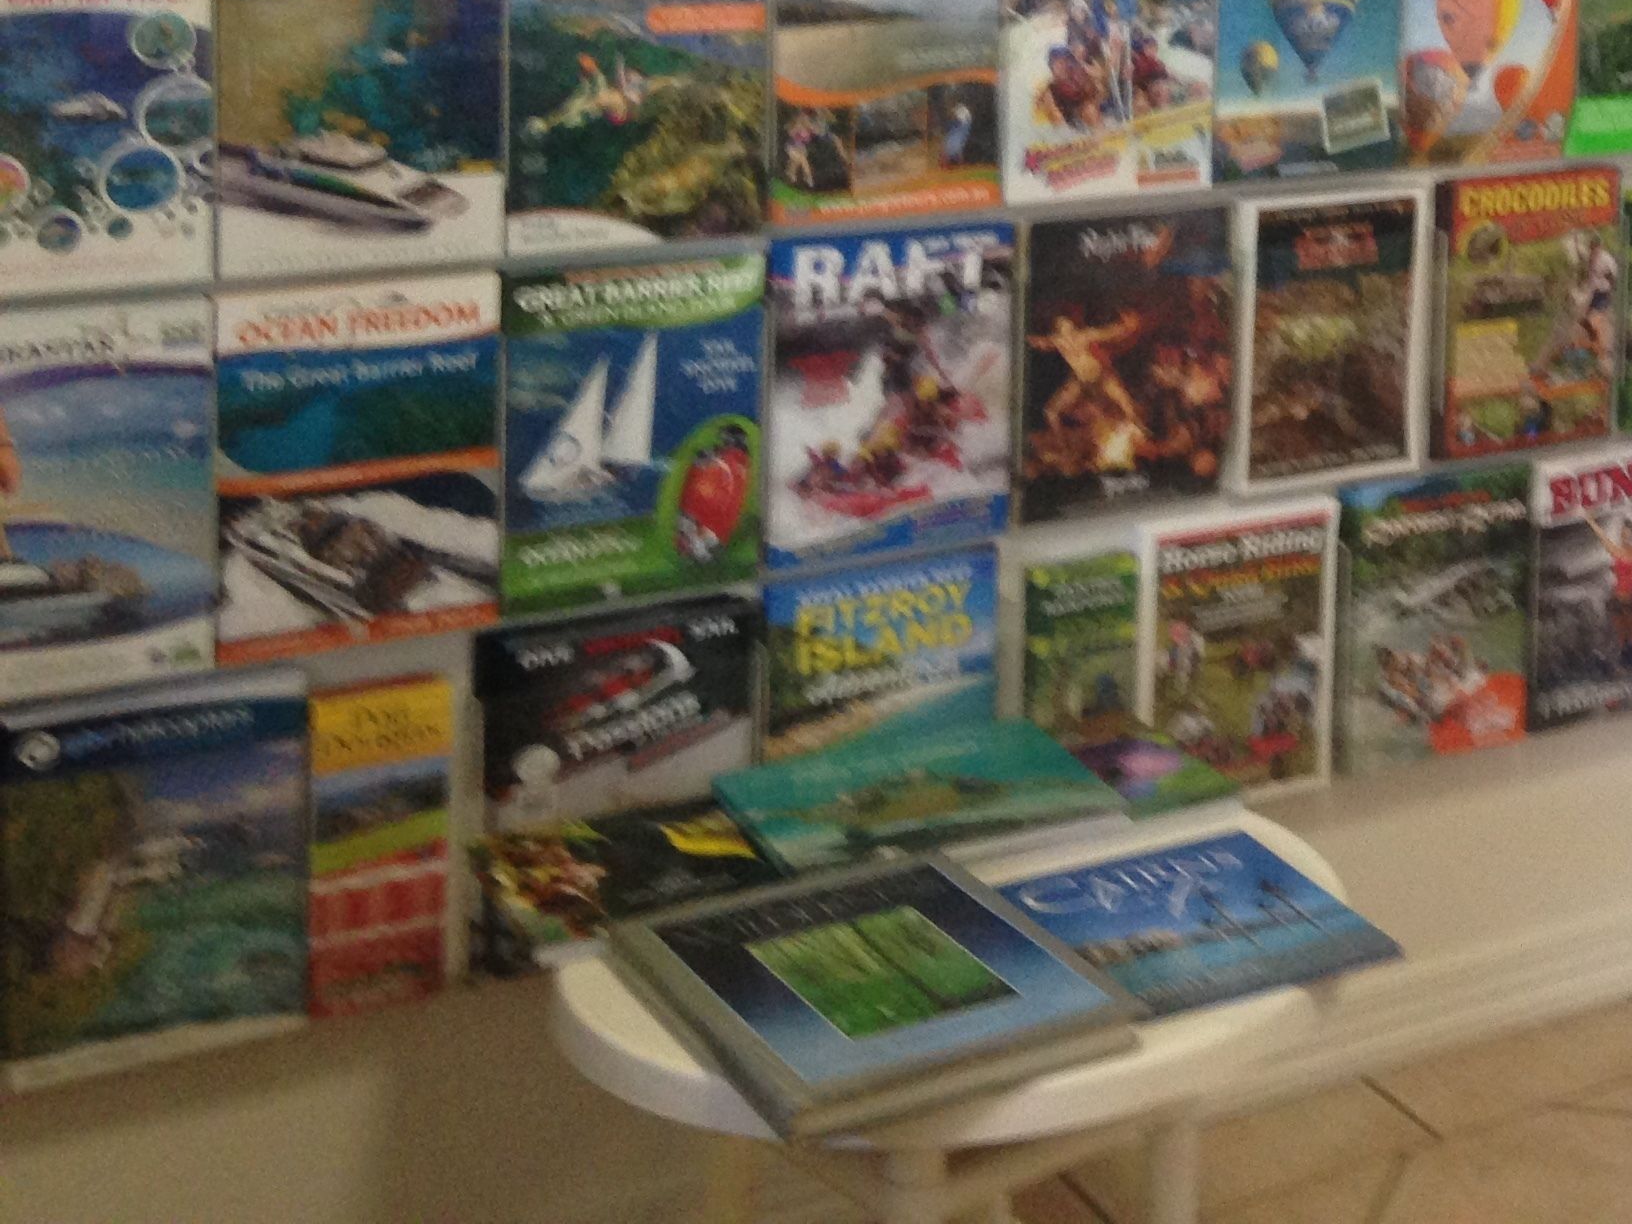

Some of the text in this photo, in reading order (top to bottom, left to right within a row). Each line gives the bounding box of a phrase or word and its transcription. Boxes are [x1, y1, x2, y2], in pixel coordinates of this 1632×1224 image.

[1458, 178, 1613, 219] CROCODILES
[790, 233, 998, 304] RAFT
[237, 301, 480, 345] OCEAN FREEDOM
[796, 613, 976, 678] ISLAND
